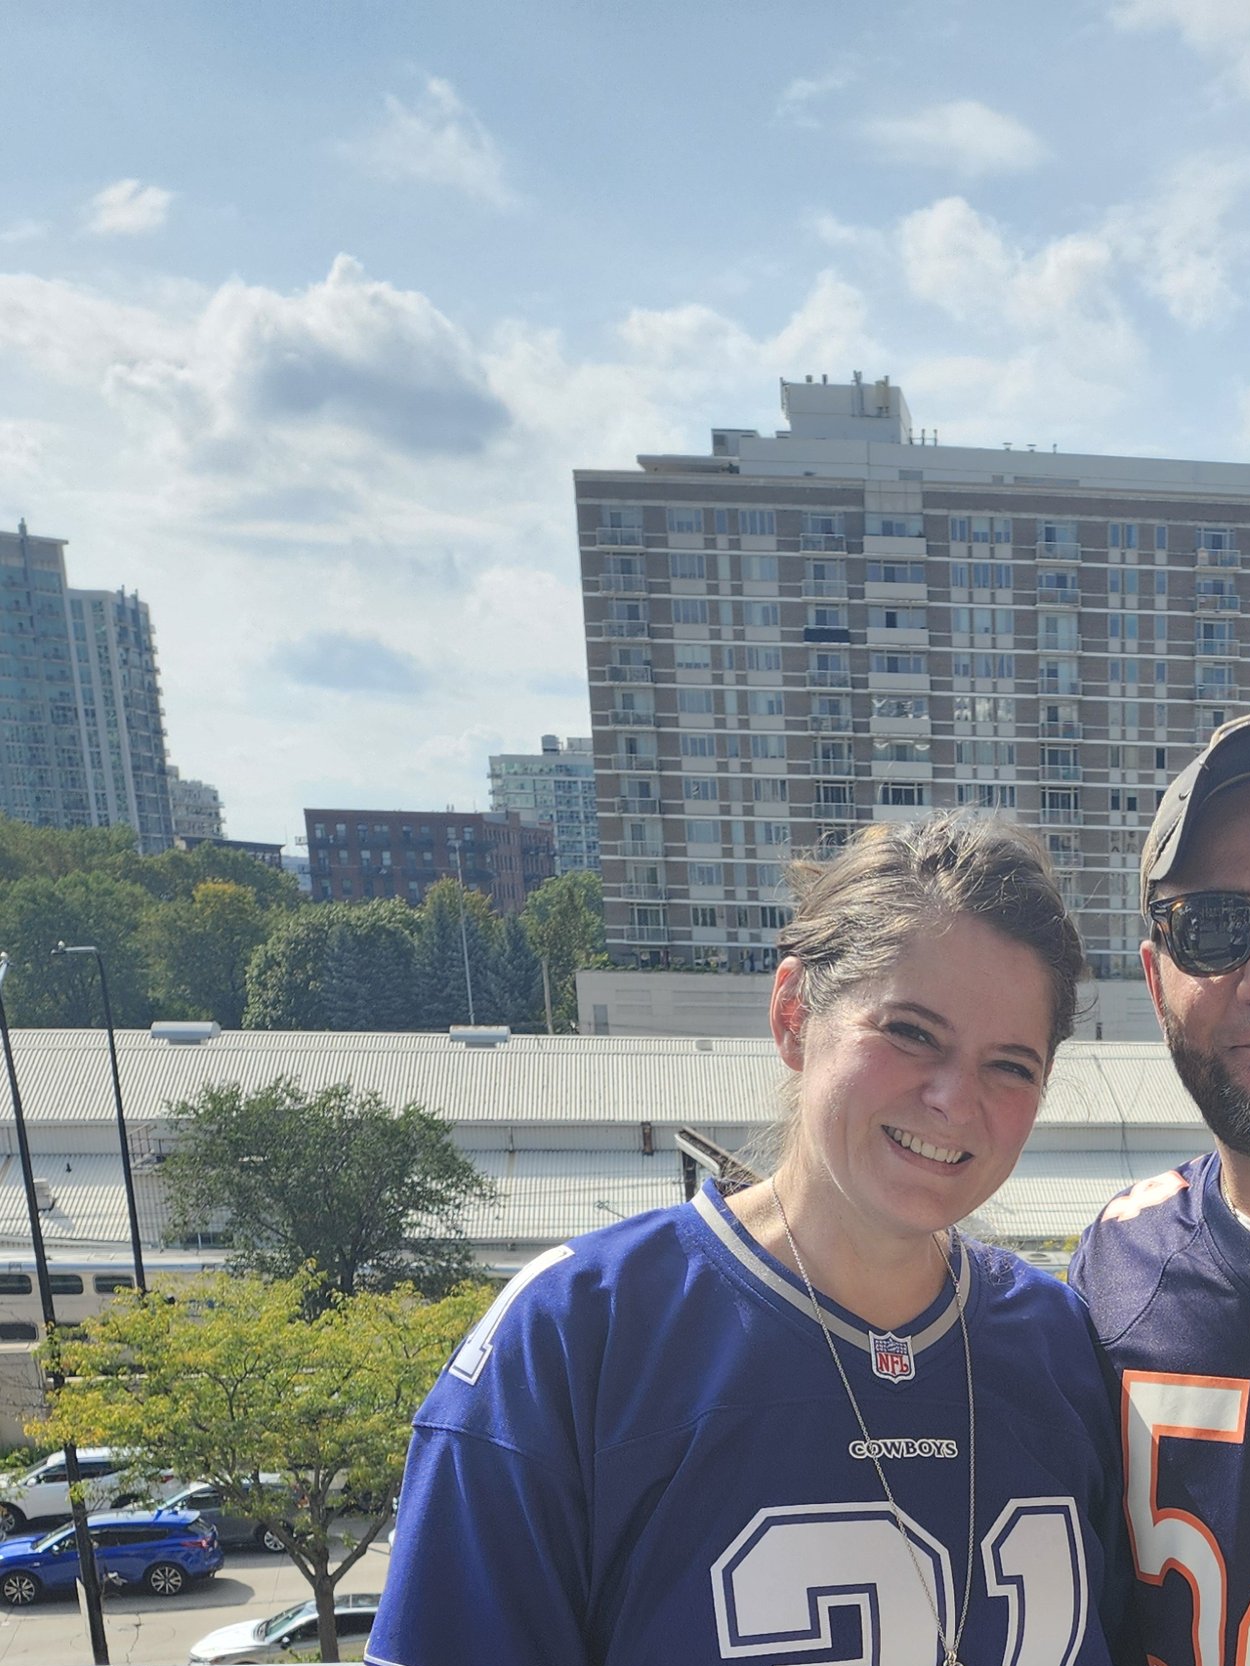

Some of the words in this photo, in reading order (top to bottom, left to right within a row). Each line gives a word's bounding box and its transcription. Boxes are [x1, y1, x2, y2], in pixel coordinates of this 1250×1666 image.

[448, 1244, 576, 1387] 1
[877, 1352, 910, 1376] NFL
[848, 1438, 959, 1459] COWBOYS
